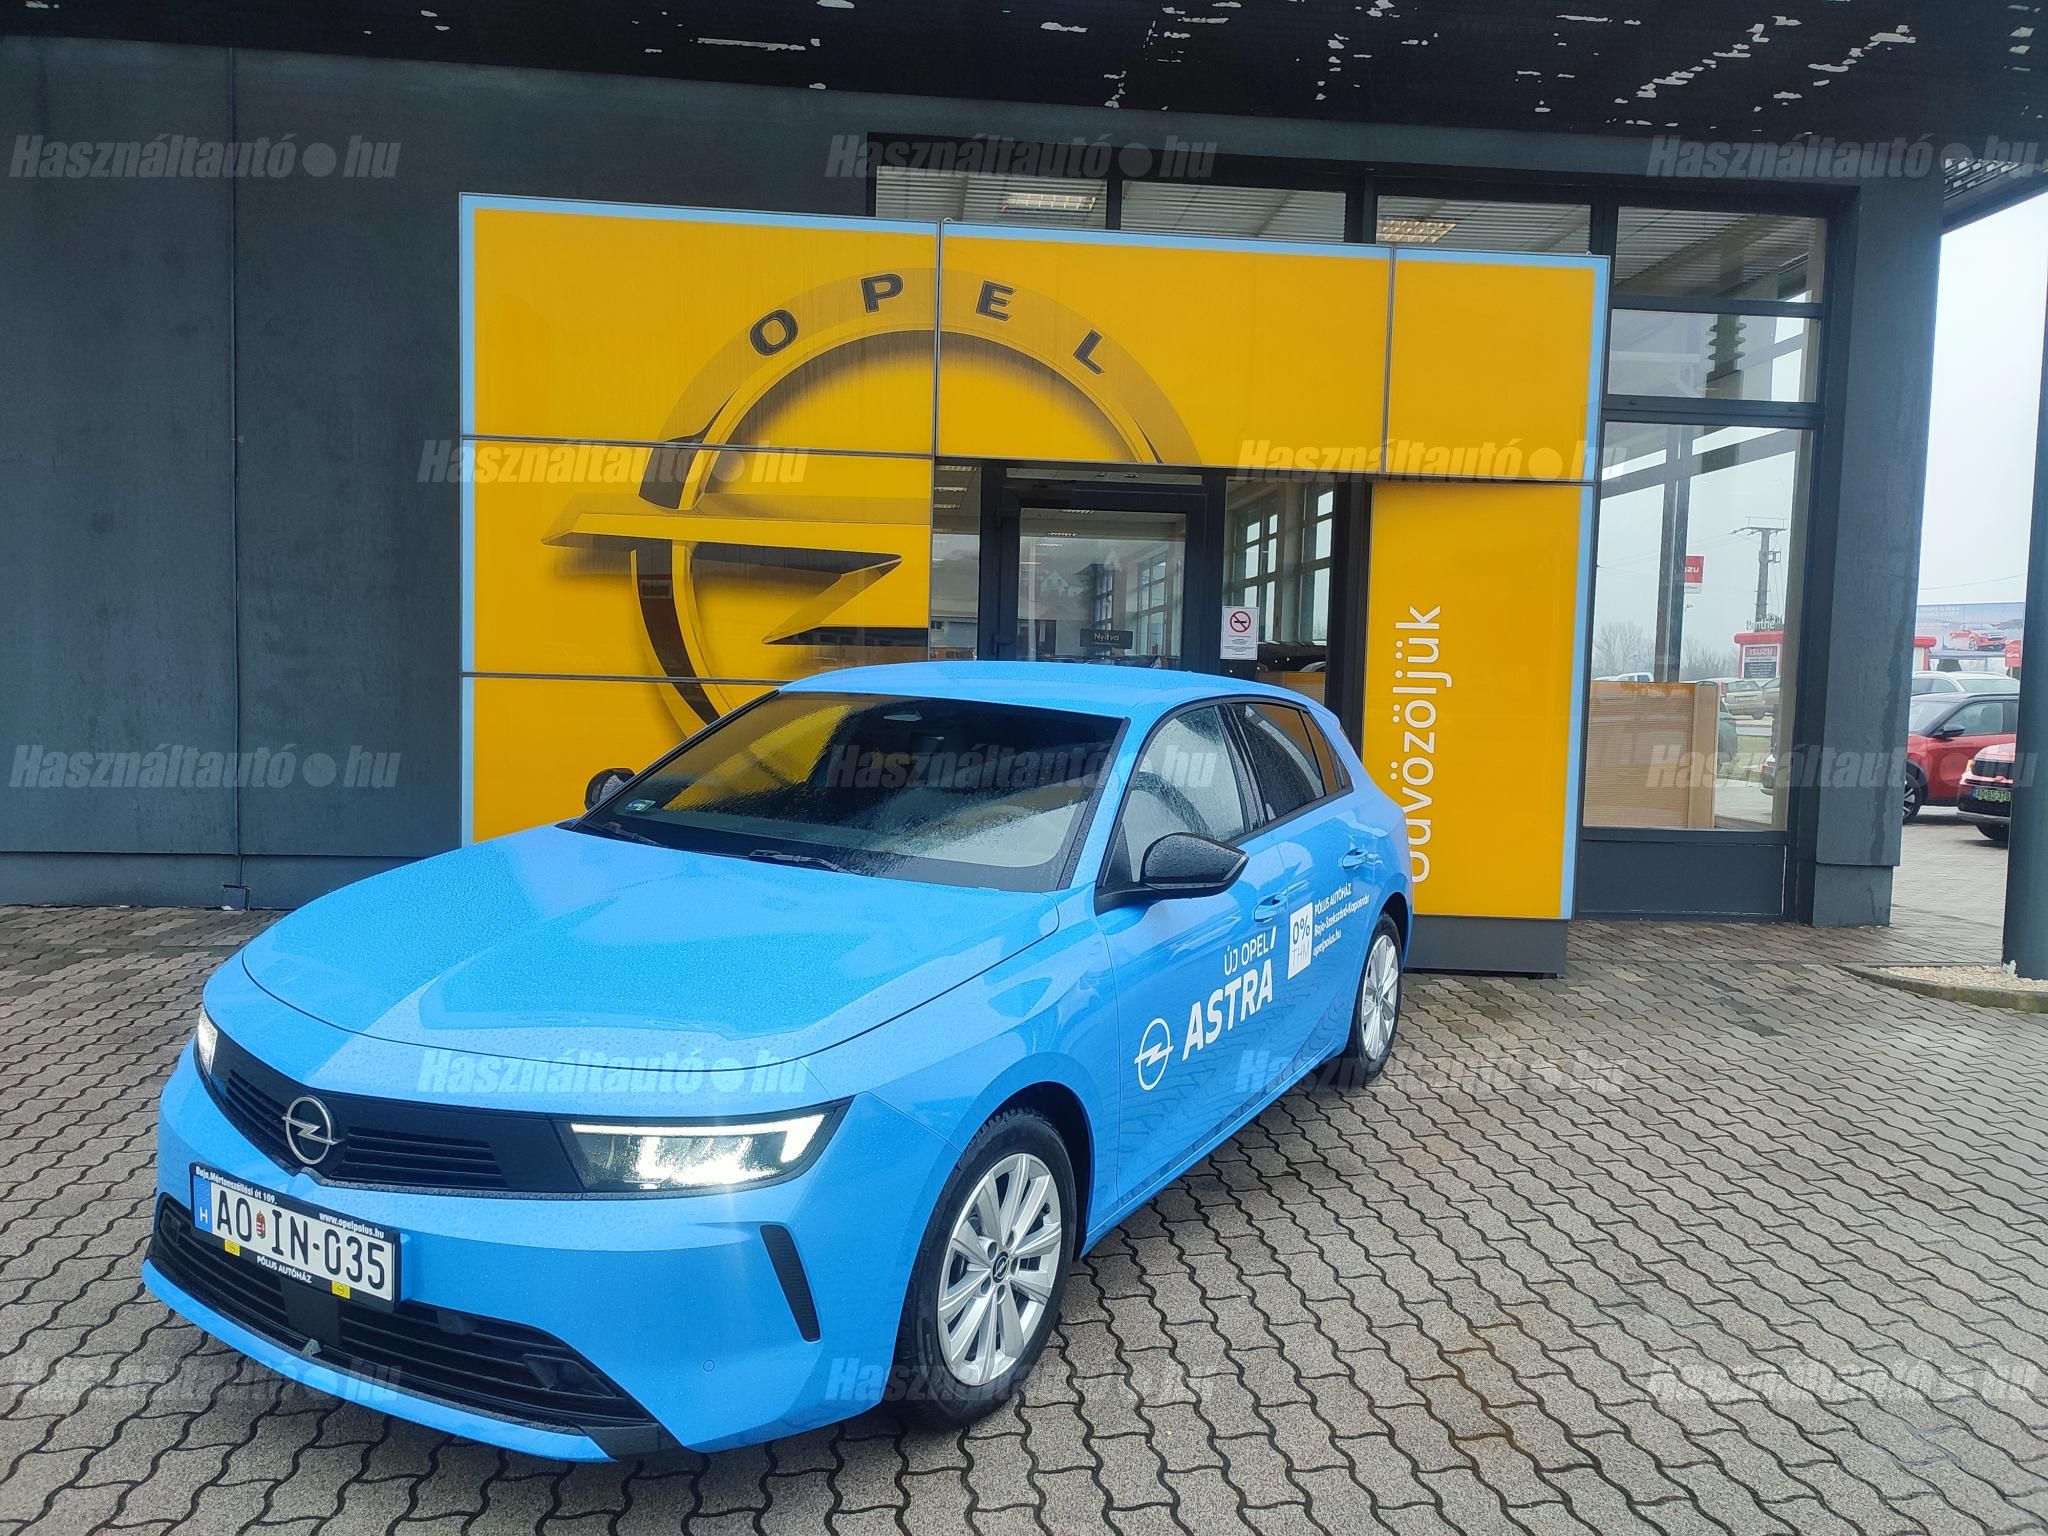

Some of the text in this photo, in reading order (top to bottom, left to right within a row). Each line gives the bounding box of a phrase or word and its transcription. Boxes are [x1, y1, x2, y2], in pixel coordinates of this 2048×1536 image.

[749, 273, 1105, 376] OPEL
[1292, 914, 1311, 945] 0%
[1224, 945, 1239, 976] ÚJ
[1182, 958, 1273, 1062] ASTRA
[200, 1206, 209, 1224] H
[319, 1212, 385, 1239] www.opelpolus.hu
[256, 1255, 313, 1284] PÓLUS AUTÓHÁZ
